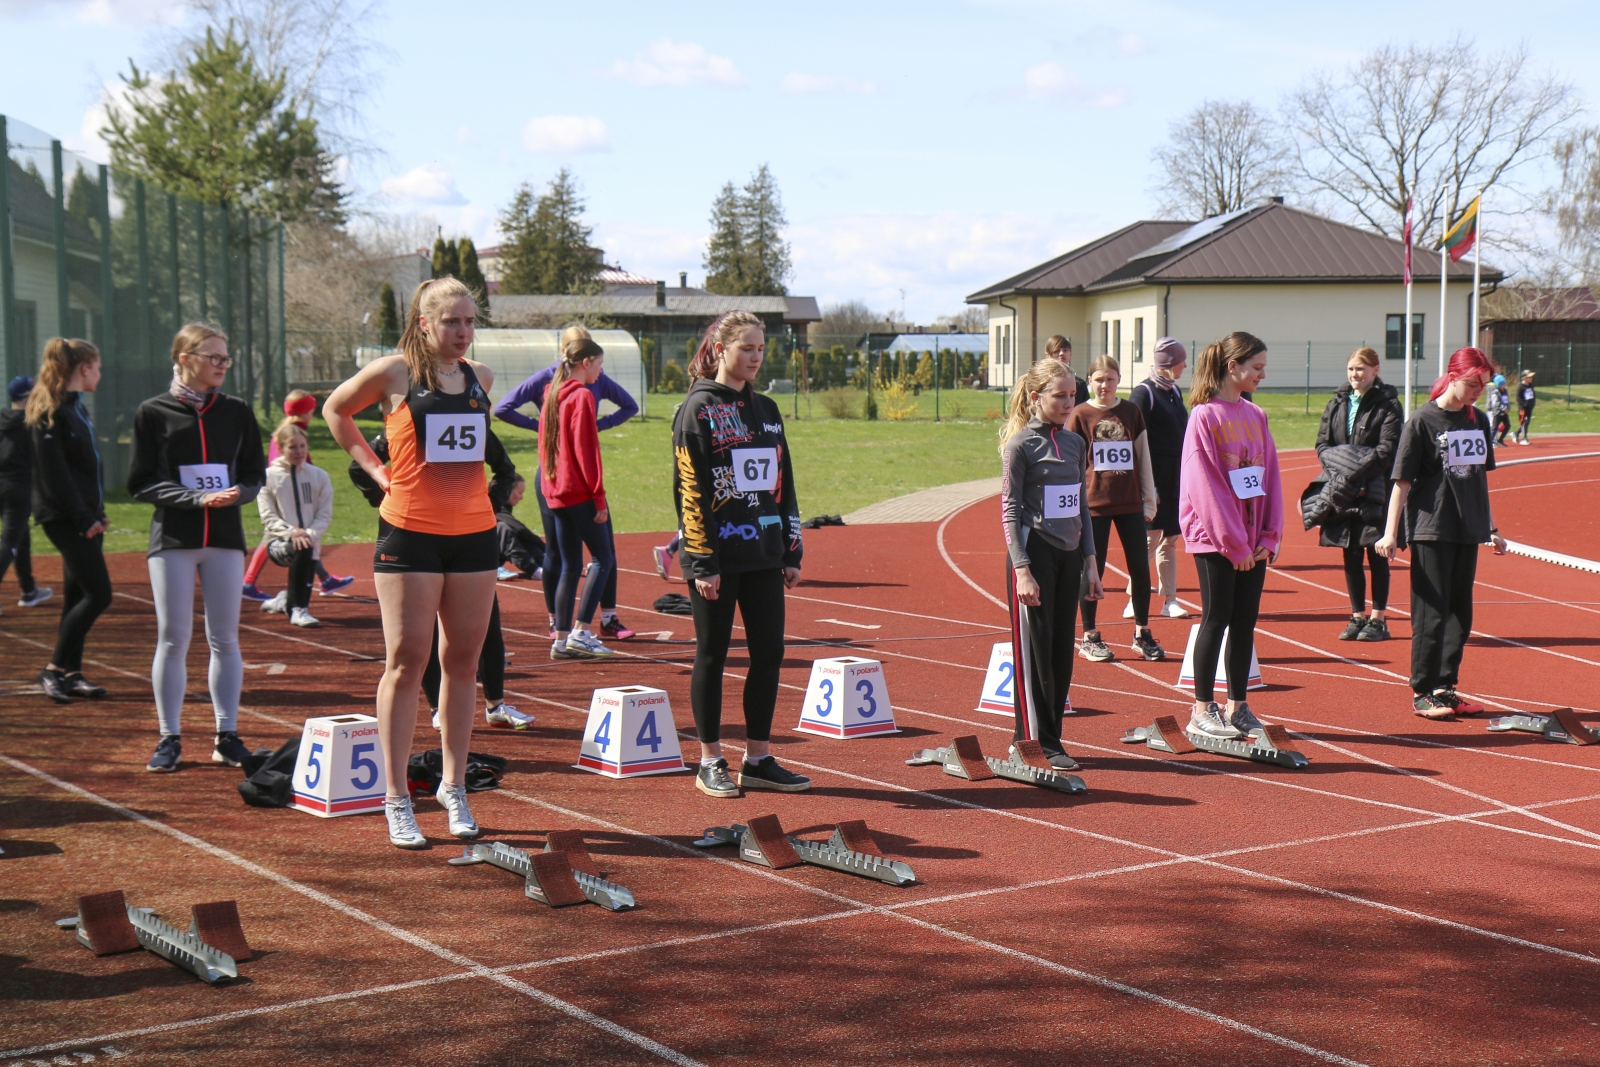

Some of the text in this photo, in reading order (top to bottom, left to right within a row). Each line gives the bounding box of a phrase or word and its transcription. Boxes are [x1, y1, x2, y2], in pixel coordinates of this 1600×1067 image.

[437, 425, 477, 450] 45
[1095, 448, 1131, 464] 169
[1450, 438, 1486, 458] 128
[743, 458, 771, 481] 67
[195, 476, 223, 490] 333
[1243, 475, 1261, 489] 33
[675, 445, 714, 555] WORLDWIDE
[1059, 494, 1078, 508] 336
[822, 666, 842, 676] polanik
[856, 665, 880, 677] polanik
[995, 661, 1015, 698] 2
[602, 697, 621, 707] polanik
[637, 695, 666, 708] polanik
[816, 678, 834, 717] 3
[855, 679, 877, 718] 3
[313, 728, 331, 739] polanik
[351, 727, 380, 740] polani
[593, 711, 612, 754] 4
[635, 710, 662, 754] 4
[305, 742, 324, 790] 5
[350, 742, 379, 791] 5
